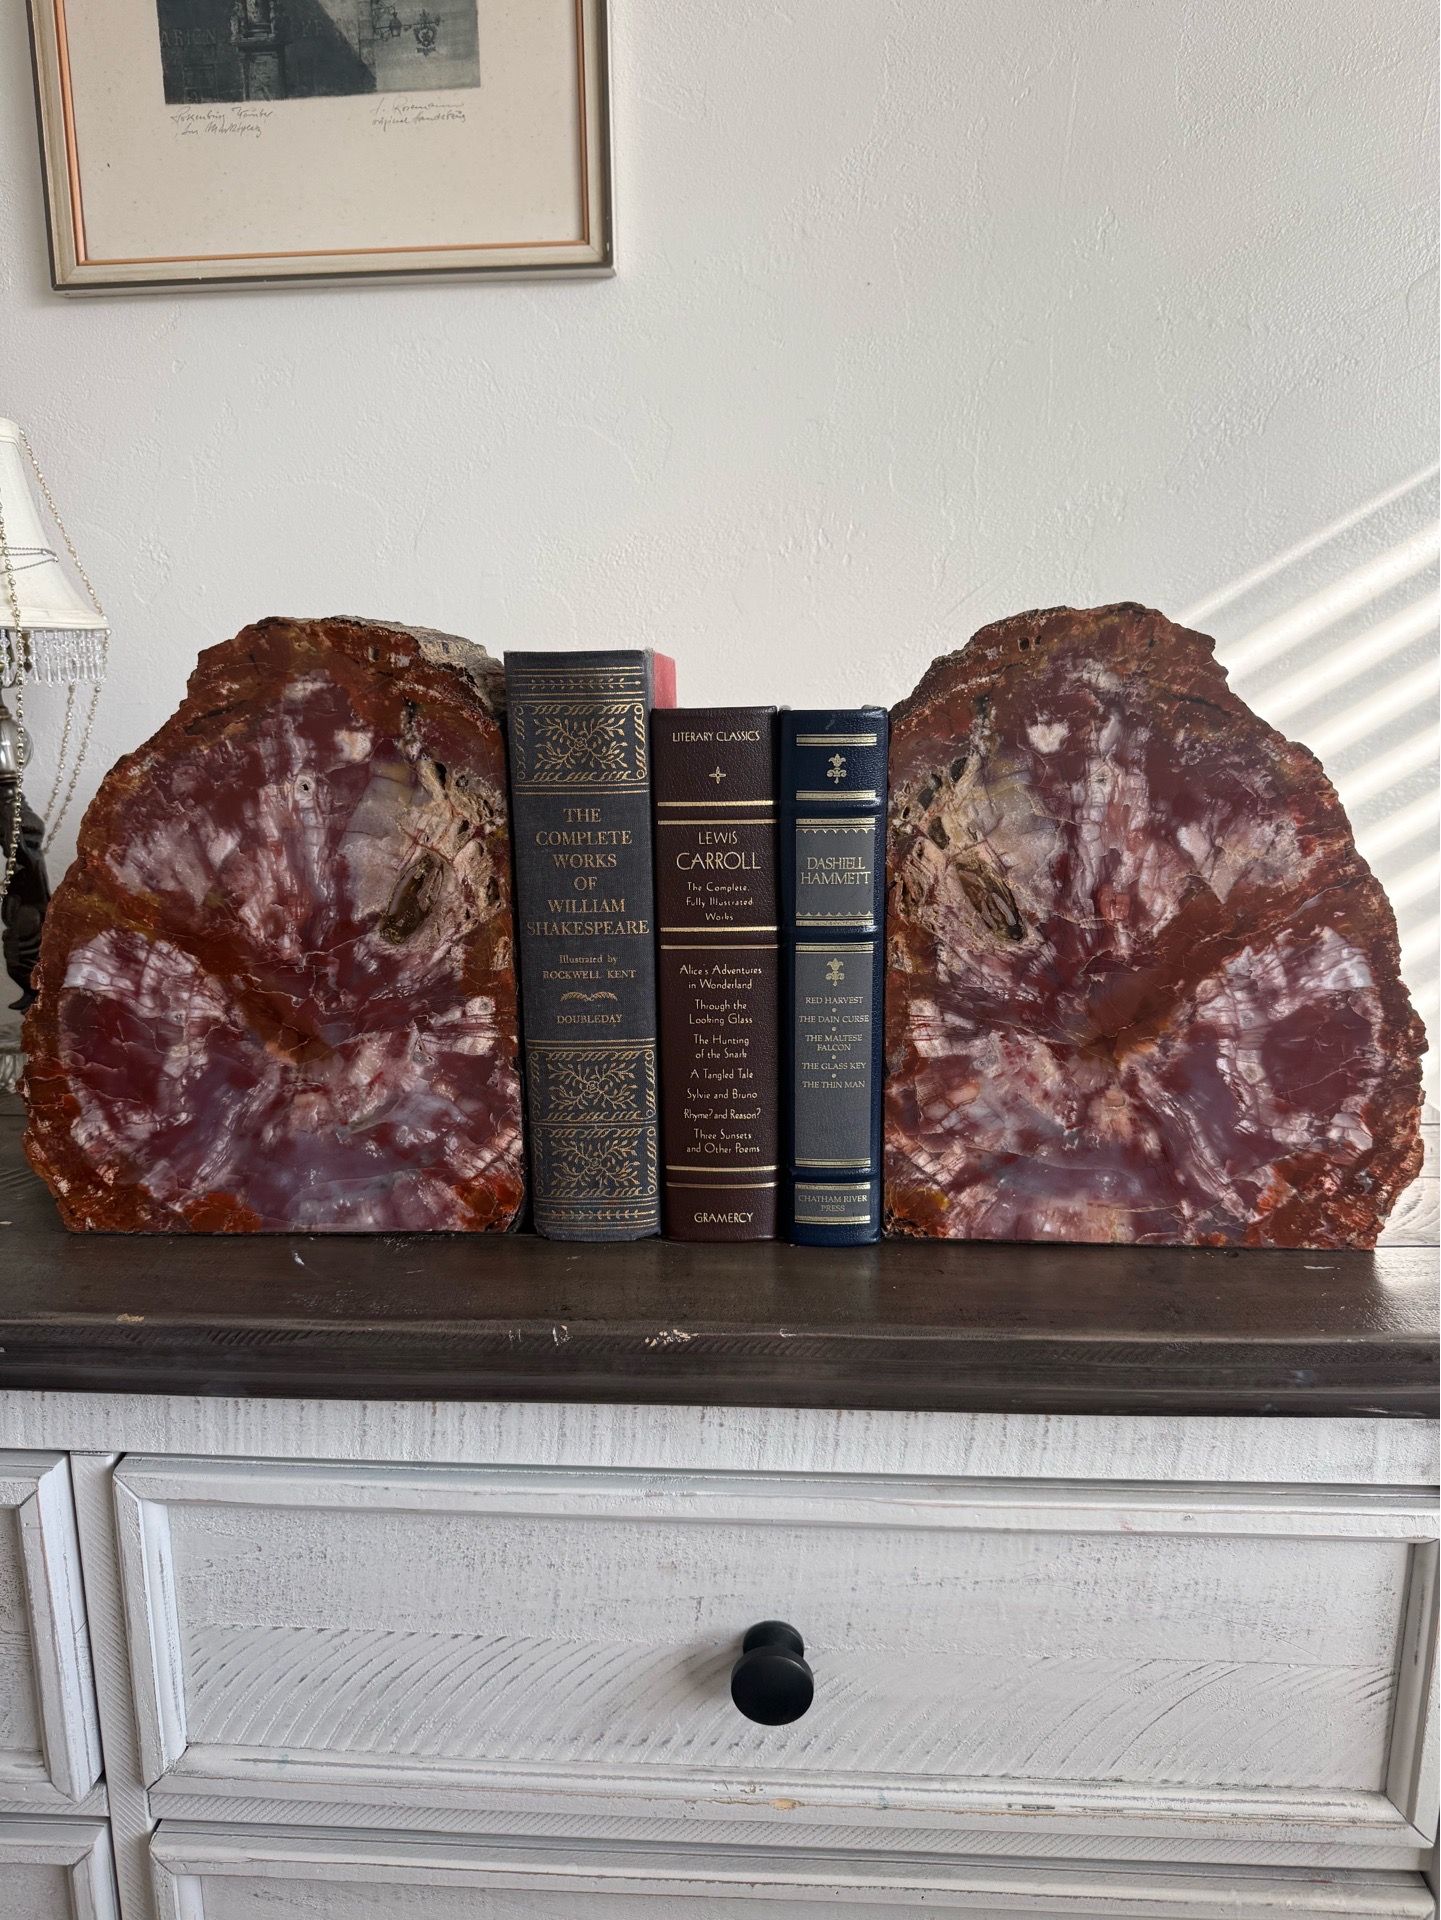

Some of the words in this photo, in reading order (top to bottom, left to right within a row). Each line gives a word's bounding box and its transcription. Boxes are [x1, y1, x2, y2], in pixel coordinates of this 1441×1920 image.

[672, 731, 714, 742] LITERARY
[716, 731, 760, 742] CLASSICS
[563, 807, 601, 823] THE
[535, 830, 632, 846] COMPLETE
[698, 831, 738, 845] LEWIS
[553, 853, 617, 869] WORKS
[676, 852, 762, 871] CARROLL
[806, 857, 865, 870] DASHIELL
[574, 876, 598, 891] OF
[801, 871, 871, 885] HAMMETT
[688, 882, 702, 891] The
[547, 899, 625, 913] WILLIAM
[686, 897, 705, 908] Fully
[709, 897, 753, 906] Illustrated
[705, 912, 734, 921] Works
[527, 920, 650, 936] SHAKESPEARE
[560, 955, 602, 964] Illustrated
[607, 955, 617, 966] by
[543, 970, 601, 979] ROCKWELL
[607, 969, 637, 979] KENT
[680, 964, 709, 975] Alice's
[711, 964, 762, 975] Adventures
[700, 979, 752, 989] Wonderland
[695, 999, 730, 1012] Through
[733, 1000, 747, 1010] the
[805, 996, 822, 1004] RED
[824, 996, 863, 1004] HARVEST
[557, 1014, 622, 1024] DOUBLEDAY
[689, 1014, 725, 1026] Looking
[728, 1013, 753, 1024] Glass
[799, 1015, 816, 1023] THE
[818, 1015, 840, 1023] DAIN
[842, 1015, 870, 1023] CURSE
[693, 1034, 709, 1044] The
[712, 1034, 749, 1046] Hunting
[805, 1034, 822, 1042] THE
[824, 1034, 863, 1042] MALTESE
[695, 1048, 704, 1058] of
[707, 1048, 720, 1058] the
[724, 1048, 747, 1058] Snark
[802, 1062, 819, 1070] THE
[821, 1062, 848, 1070] GLASS
[690, 1069, 699, 1079] A
[703, 1068, 734, 1081] Tangled
[738, 1068, 754, 1079] Tale
[844, 1080, 865, 1088] MAN
[687, 1088, 710, 1101] Sylvie
[713, 1089, 729, 1099] and
[732, 1088, 758, 1099] Bruno
[684, 1108, 713, 1121] Rhyme?
[714, 1109, 728, 1119] and
[730, 1108, 761, 1120] Reason?
[694, 1128, 717, 1139] Three
[720, 1128, 752, 1140] Sunsets
[686, 1143, 701, 1153] and
[704, 1142, 731, 1153] Other
[735, 1142, 760, 1153] Poems
[798, 1195, 841, 1203] CHATHAM
[843, 1194, 868, 1203] RIVER
[821, 1204, 845, 1212] PRESS
[694, 1213, 753, 1223] GRAMERCY
